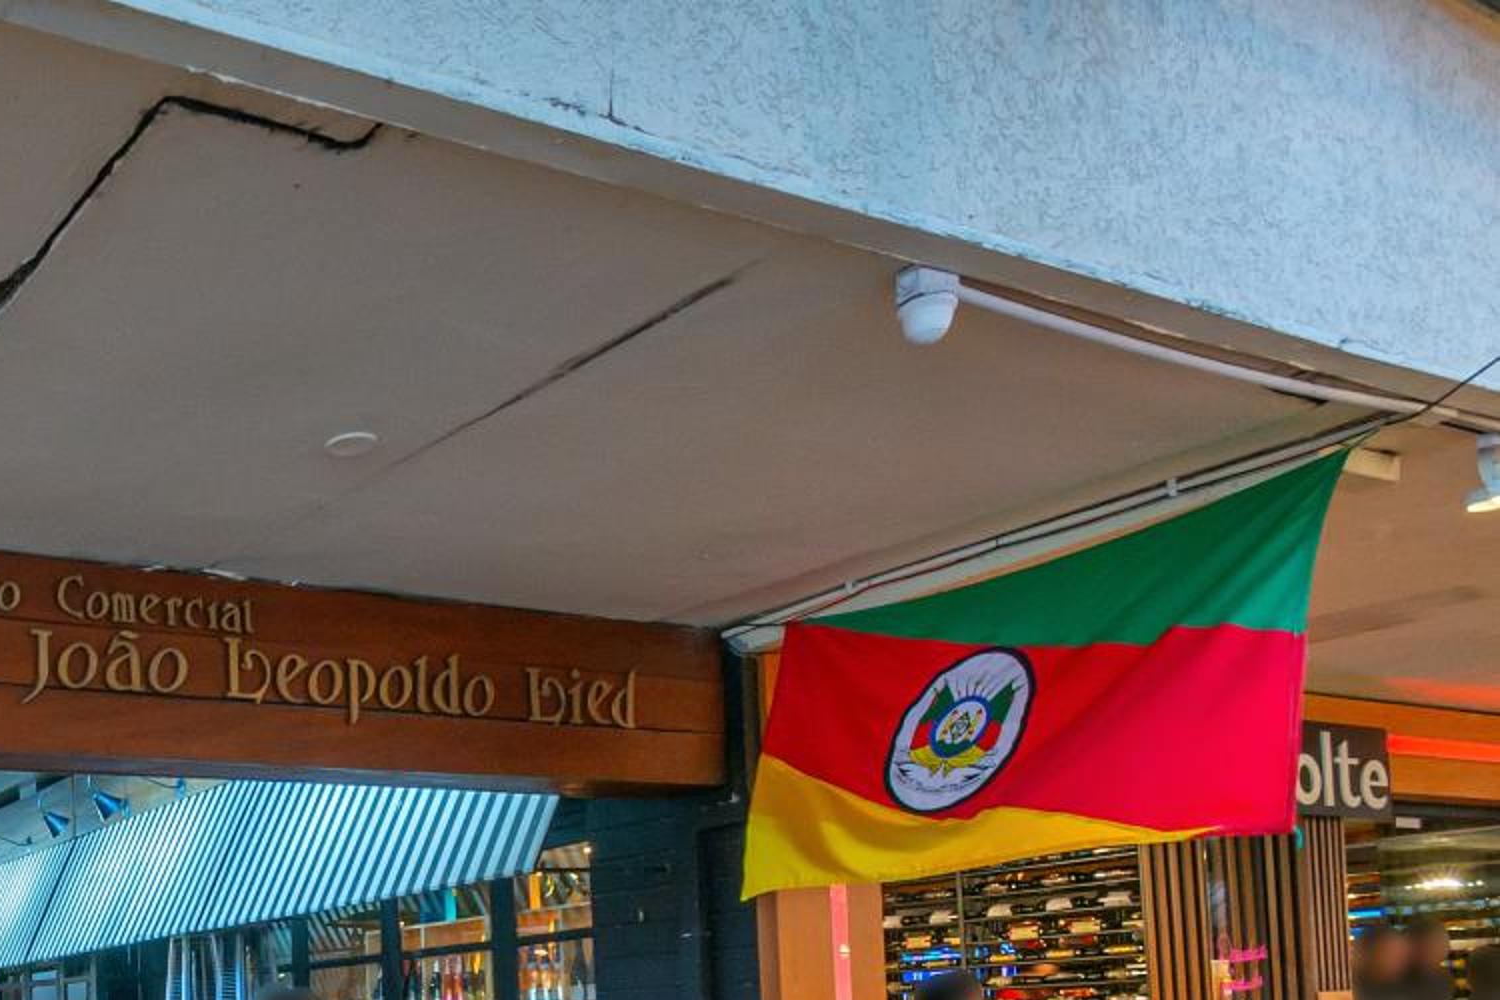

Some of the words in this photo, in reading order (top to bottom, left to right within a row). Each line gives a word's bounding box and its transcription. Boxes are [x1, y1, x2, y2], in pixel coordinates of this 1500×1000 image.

[57, 575, 255, 634] Comercial
[21, 628, 189, 704] João
[223, 638, 496, 725] Leopoldo
